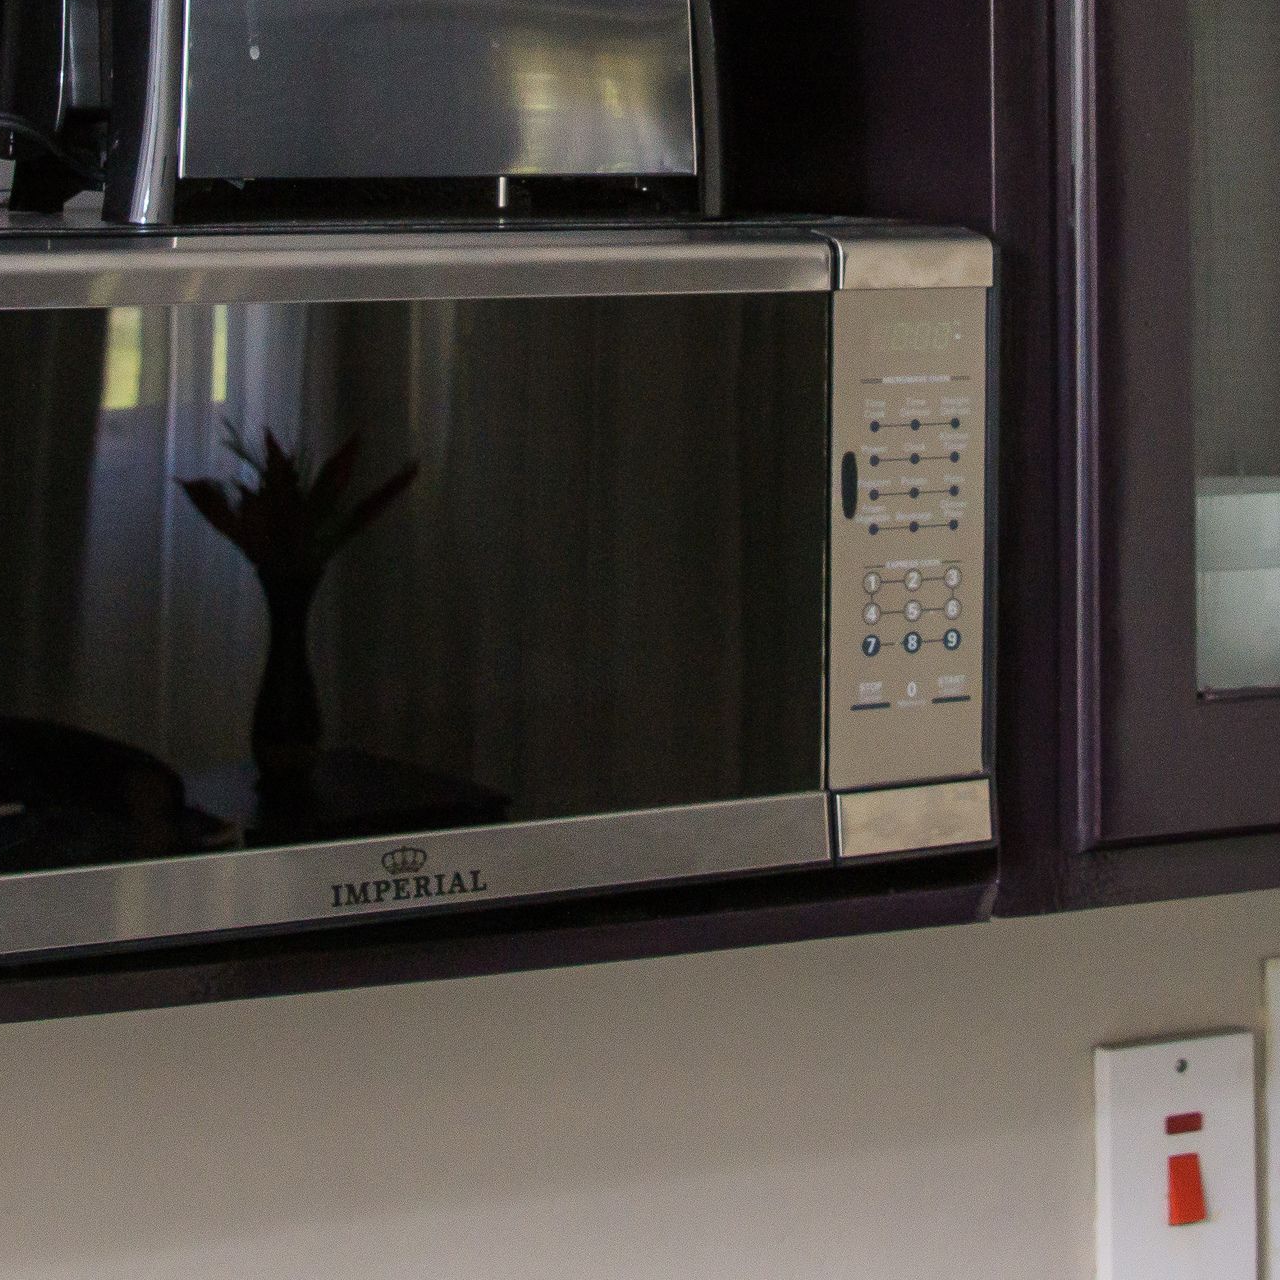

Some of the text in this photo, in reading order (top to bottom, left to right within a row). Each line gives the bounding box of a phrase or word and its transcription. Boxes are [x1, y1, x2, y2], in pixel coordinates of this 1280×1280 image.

[866, 631, 957, 654] 7 8 9
[331, 869, 487, 907] IMPERIAL
